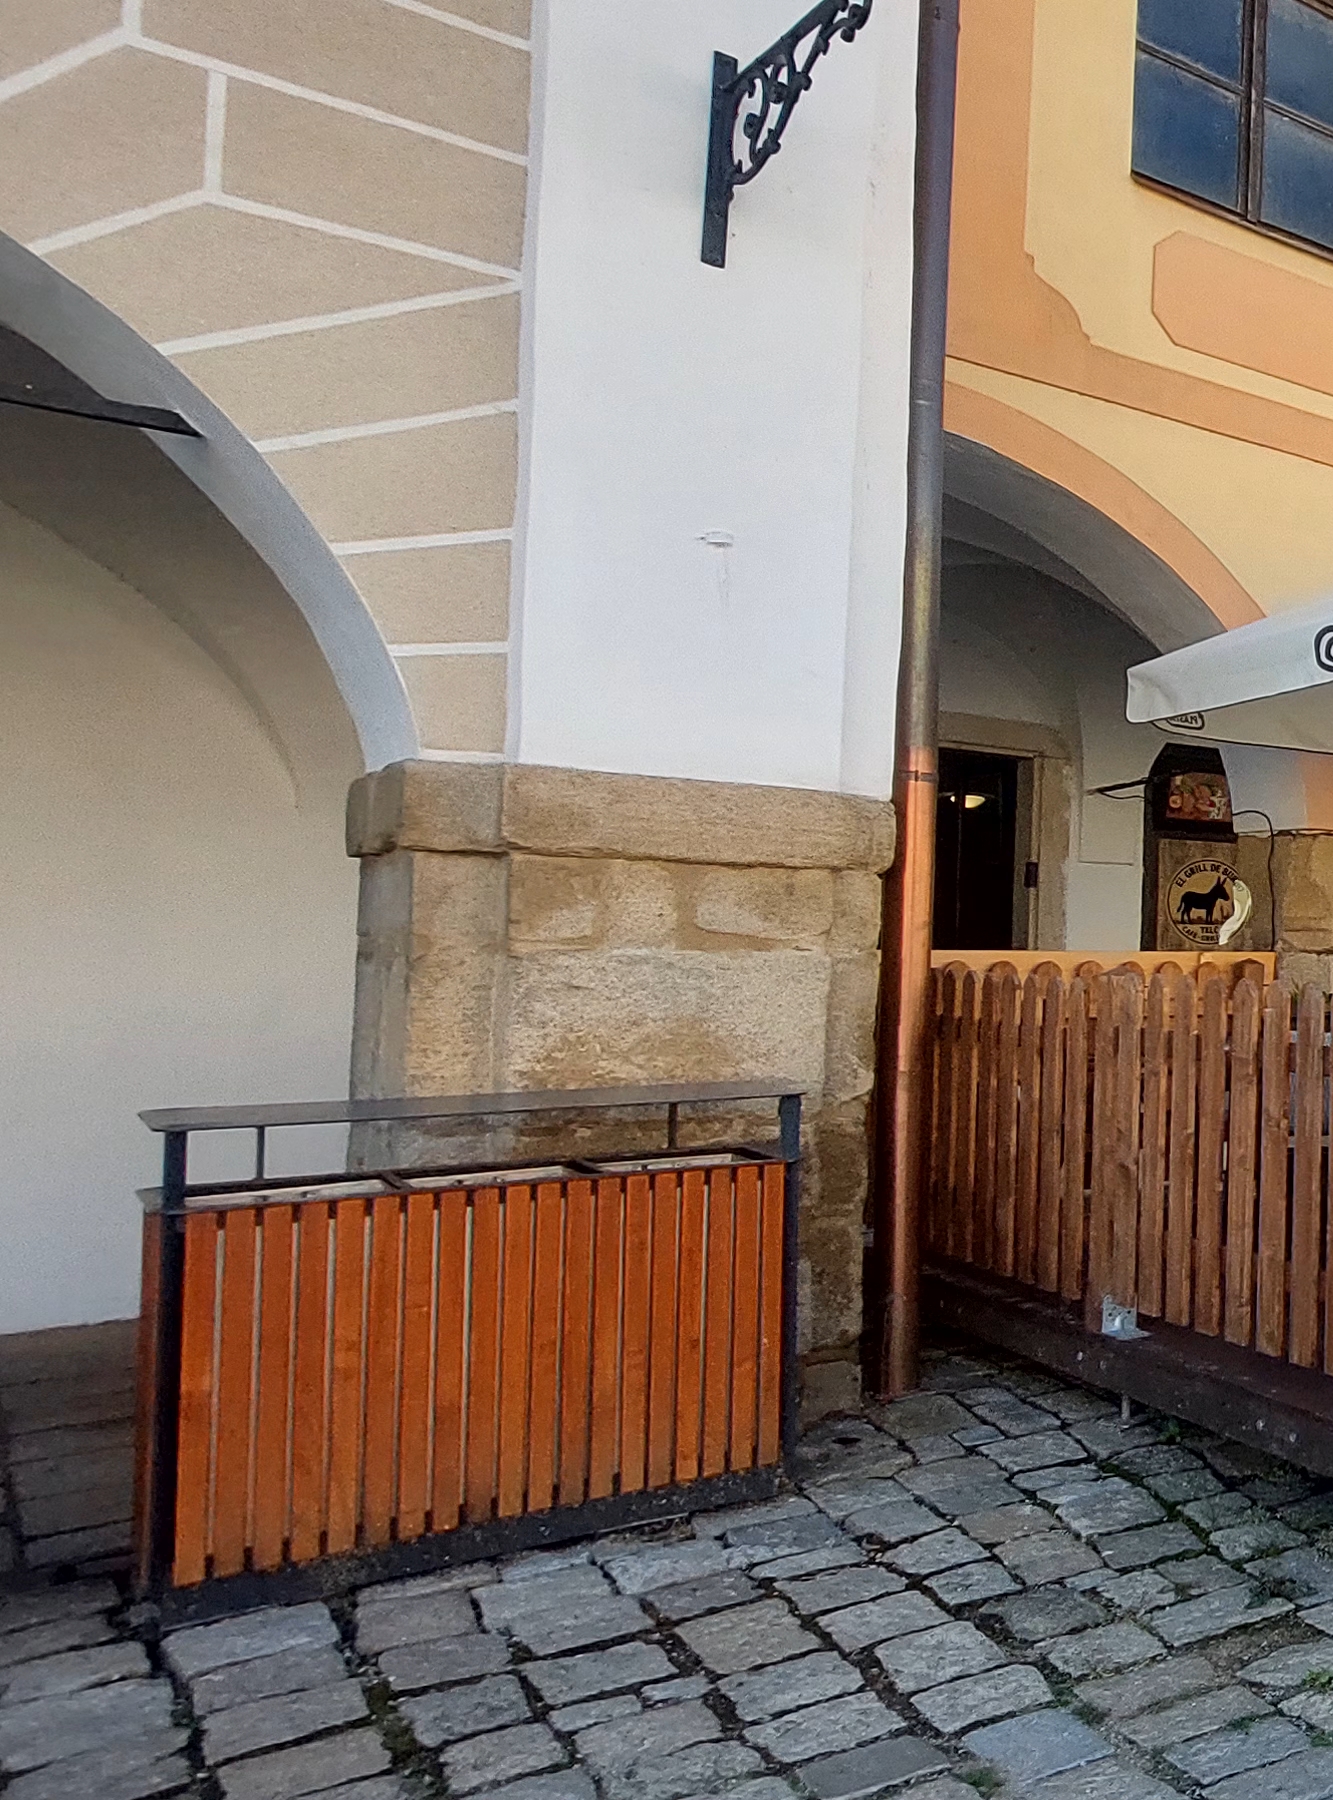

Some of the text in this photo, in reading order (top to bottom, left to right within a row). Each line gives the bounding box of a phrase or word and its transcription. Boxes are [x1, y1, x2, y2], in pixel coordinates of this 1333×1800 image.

[1175, 877, 1187, 888] EL
[1183, 863, 1208, 878] GRILL
[1210, 863, 1222, 873] DE
